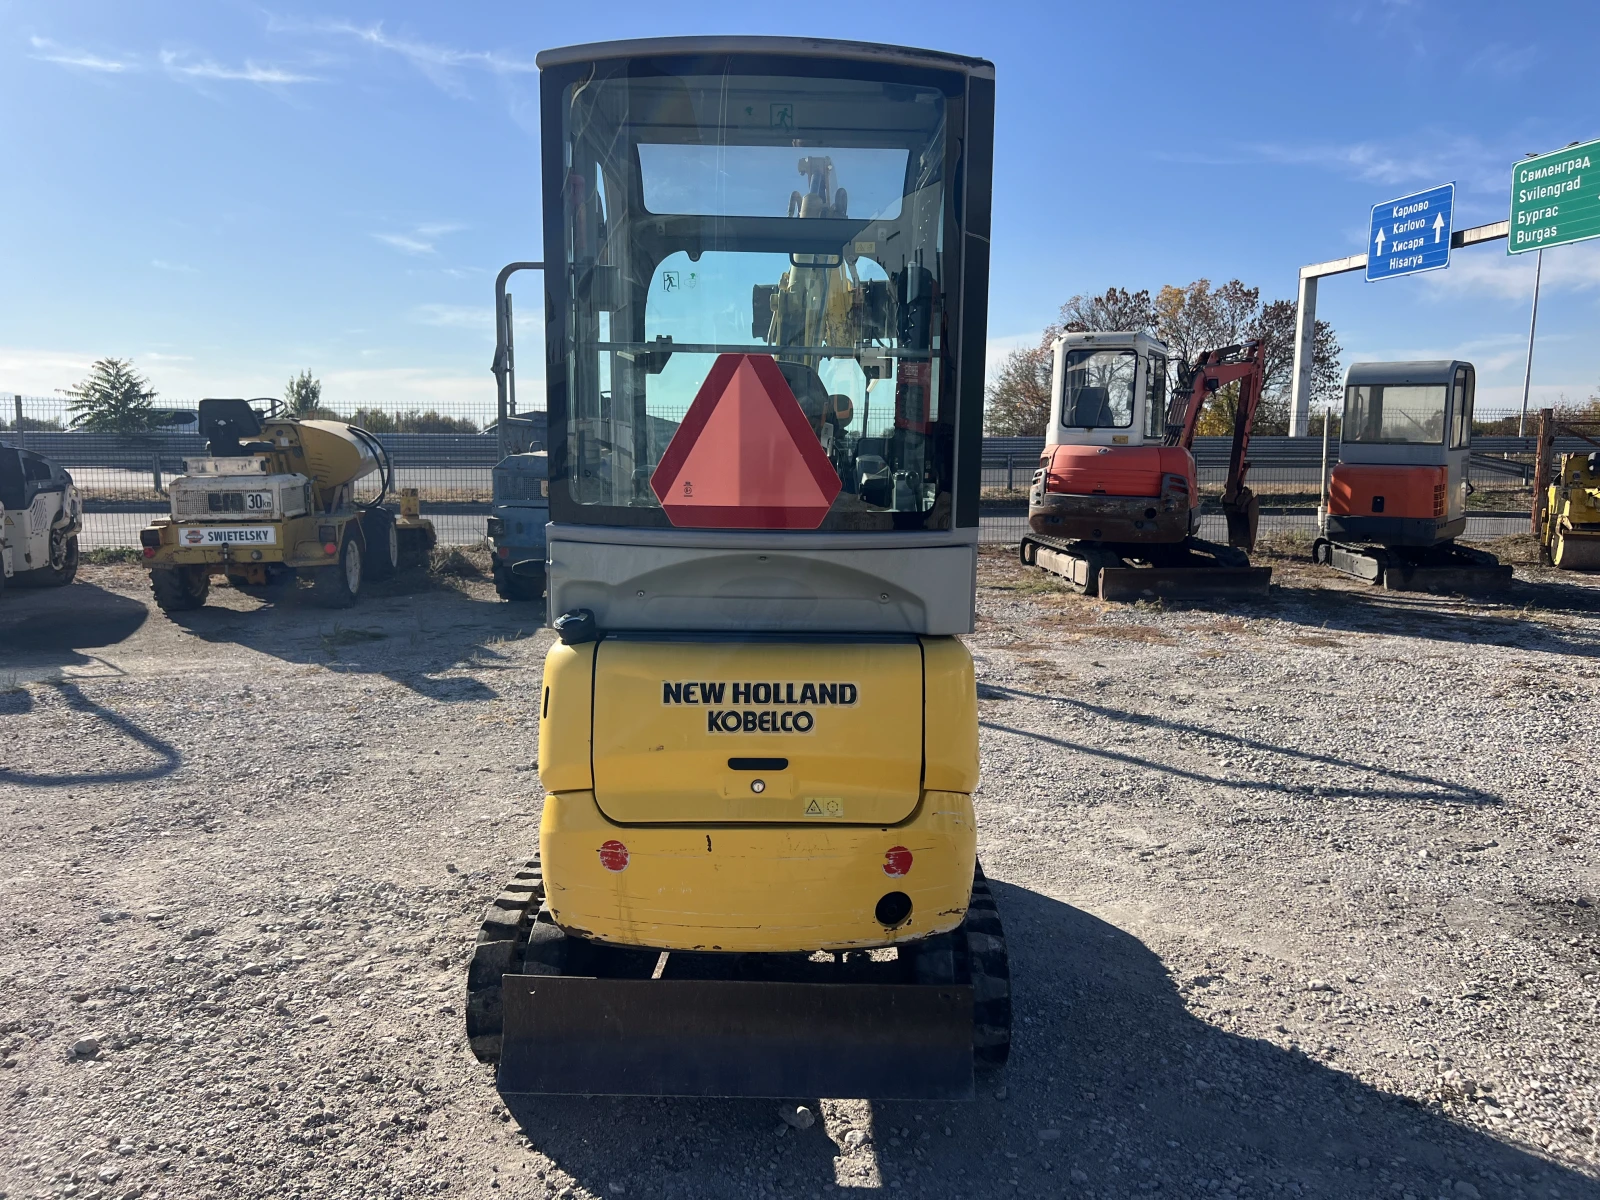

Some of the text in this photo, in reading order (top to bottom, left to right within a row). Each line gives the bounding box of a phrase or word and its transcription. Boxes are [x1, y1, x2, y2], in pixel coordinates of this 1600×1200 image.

[1520, 155, 1591, 184] Свиленград
[1519, 175, 1580, 203] Svilengrad
[1392, 200, 1429, 218] Карлово
[1517, 204, 1559, 226] Бургас
[1392, 218, 1426, 235] Karlovo
[1516, 226, 1557, 243] Burgas
[1391, 236, 1425, 253] Хисаря
[1389, 255, 1423, 270] Hisarya
[208, 530, 268, 541] SWIETELSKY
[663, 682, 857, 705] NEW HOLLAND
[707, 710, 814, 733] KOBELCO
